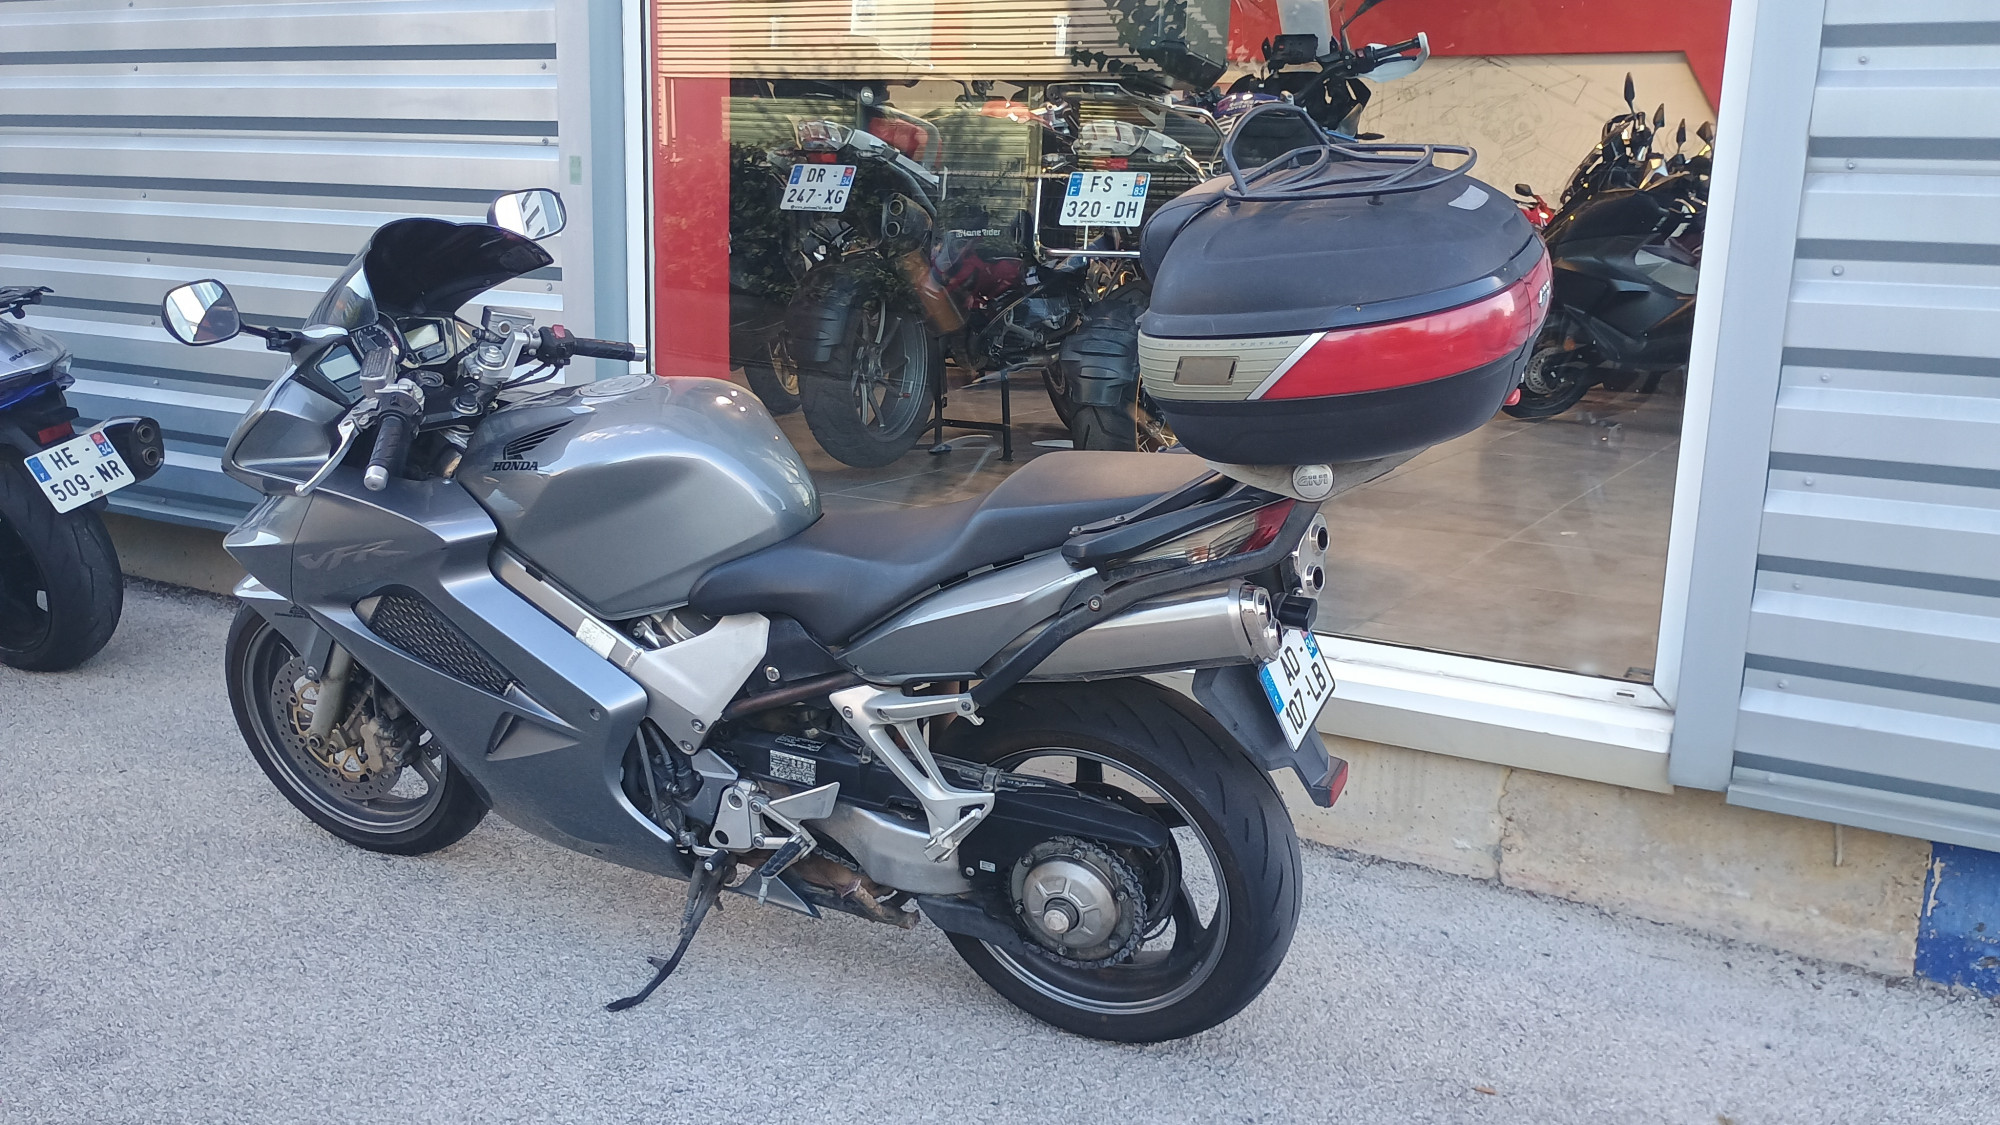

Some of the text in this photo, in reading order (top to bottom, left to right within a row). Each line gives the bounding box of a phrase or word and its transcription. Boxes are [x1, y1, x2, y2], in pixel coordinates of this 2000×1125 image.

[807, 168, 826, 182] DR
[841, 176, 850, 185] 34
[1090, 176, 1113, 192] FS
[1069, 186, 1077, 195] F
[1133, 187, 1144, 195] 83
[97, 444, 113, 455] 34
[49, 447, 79, 471] HE
[492, 461, 538, 471] HONDA
[297, 539, 409, 571] VFR
[1280, 646, 1301, 686] AD
